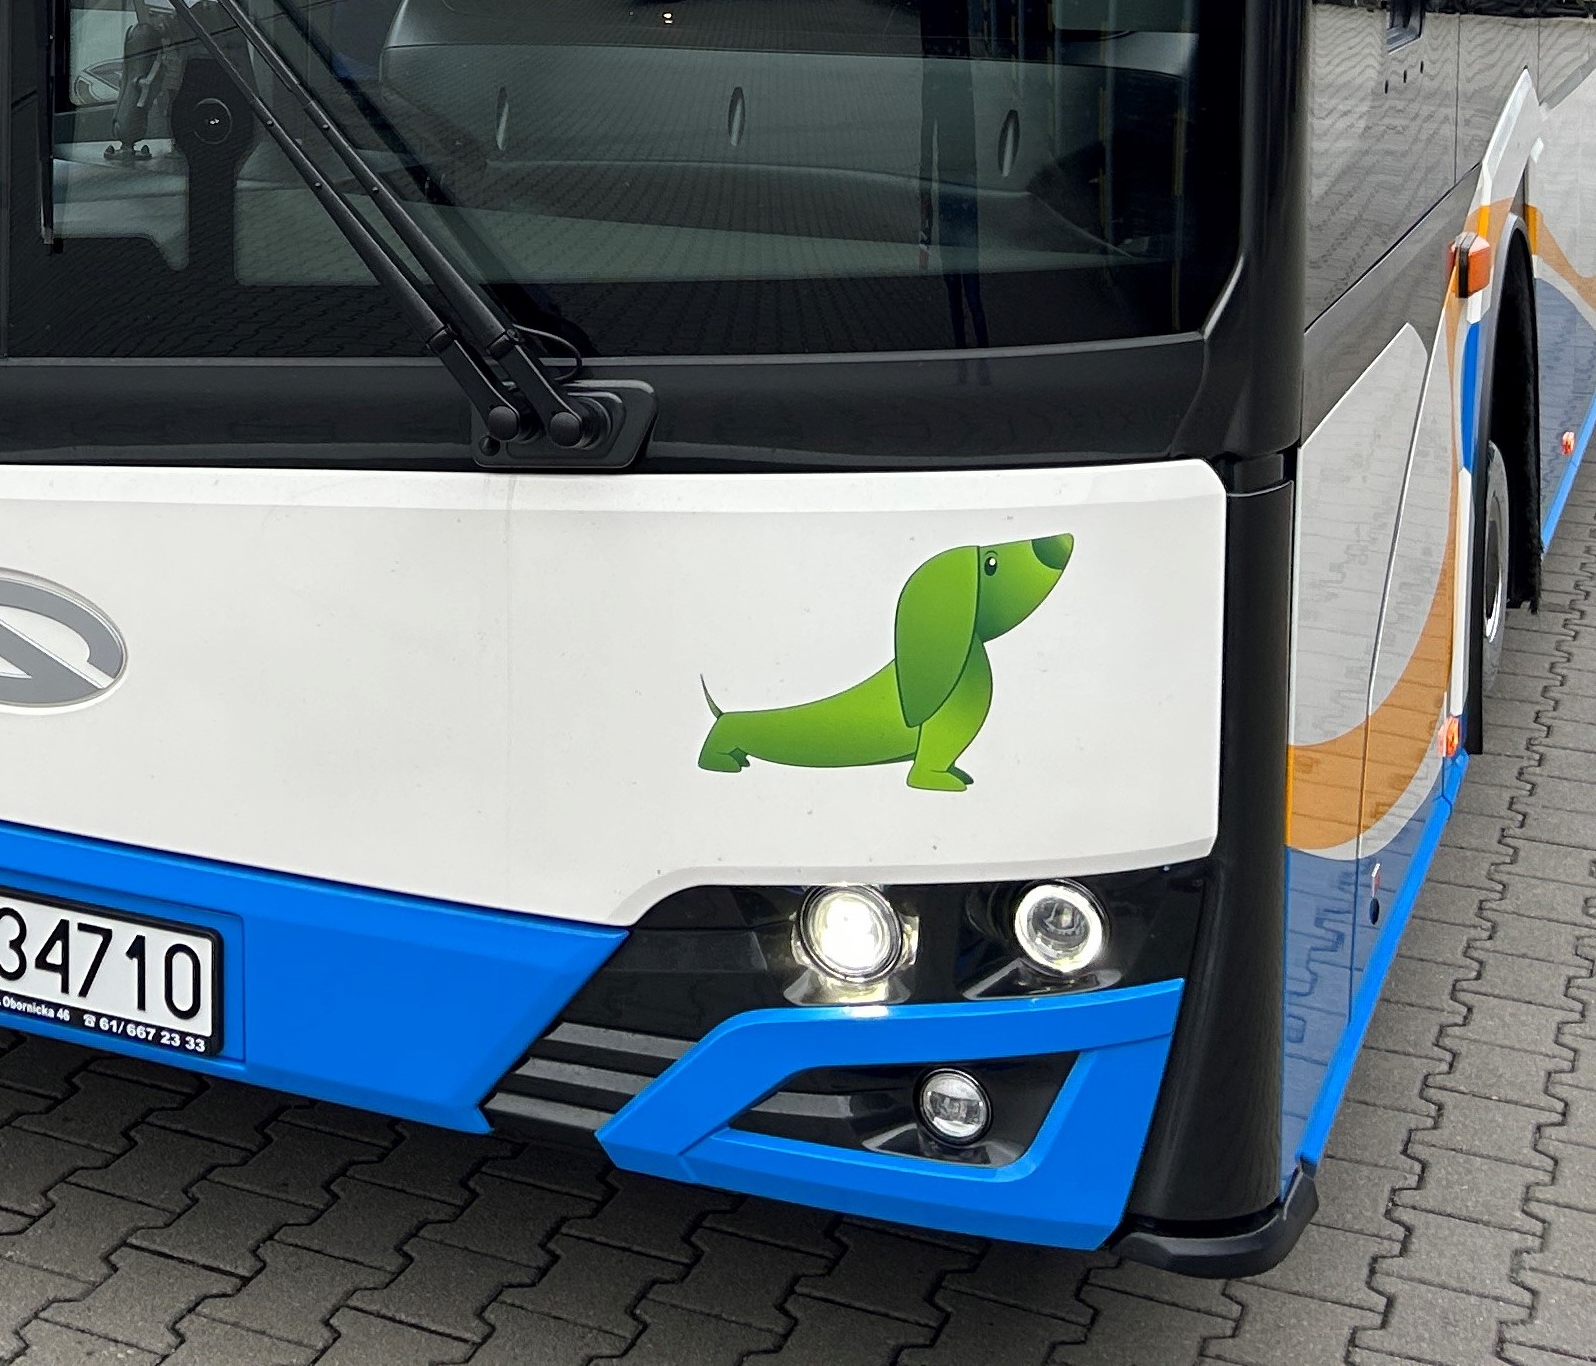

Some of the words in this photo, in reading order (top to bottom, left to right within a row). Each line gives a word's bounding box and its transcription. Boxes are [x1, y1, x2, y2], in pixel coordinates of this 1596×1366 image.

[2, 996, 55, 1019] Obornicka
[126, 1021, 157, 1041] 667
[160, 1031, 181, 1047] 23
[184, 1036, 205, 1053] 33
